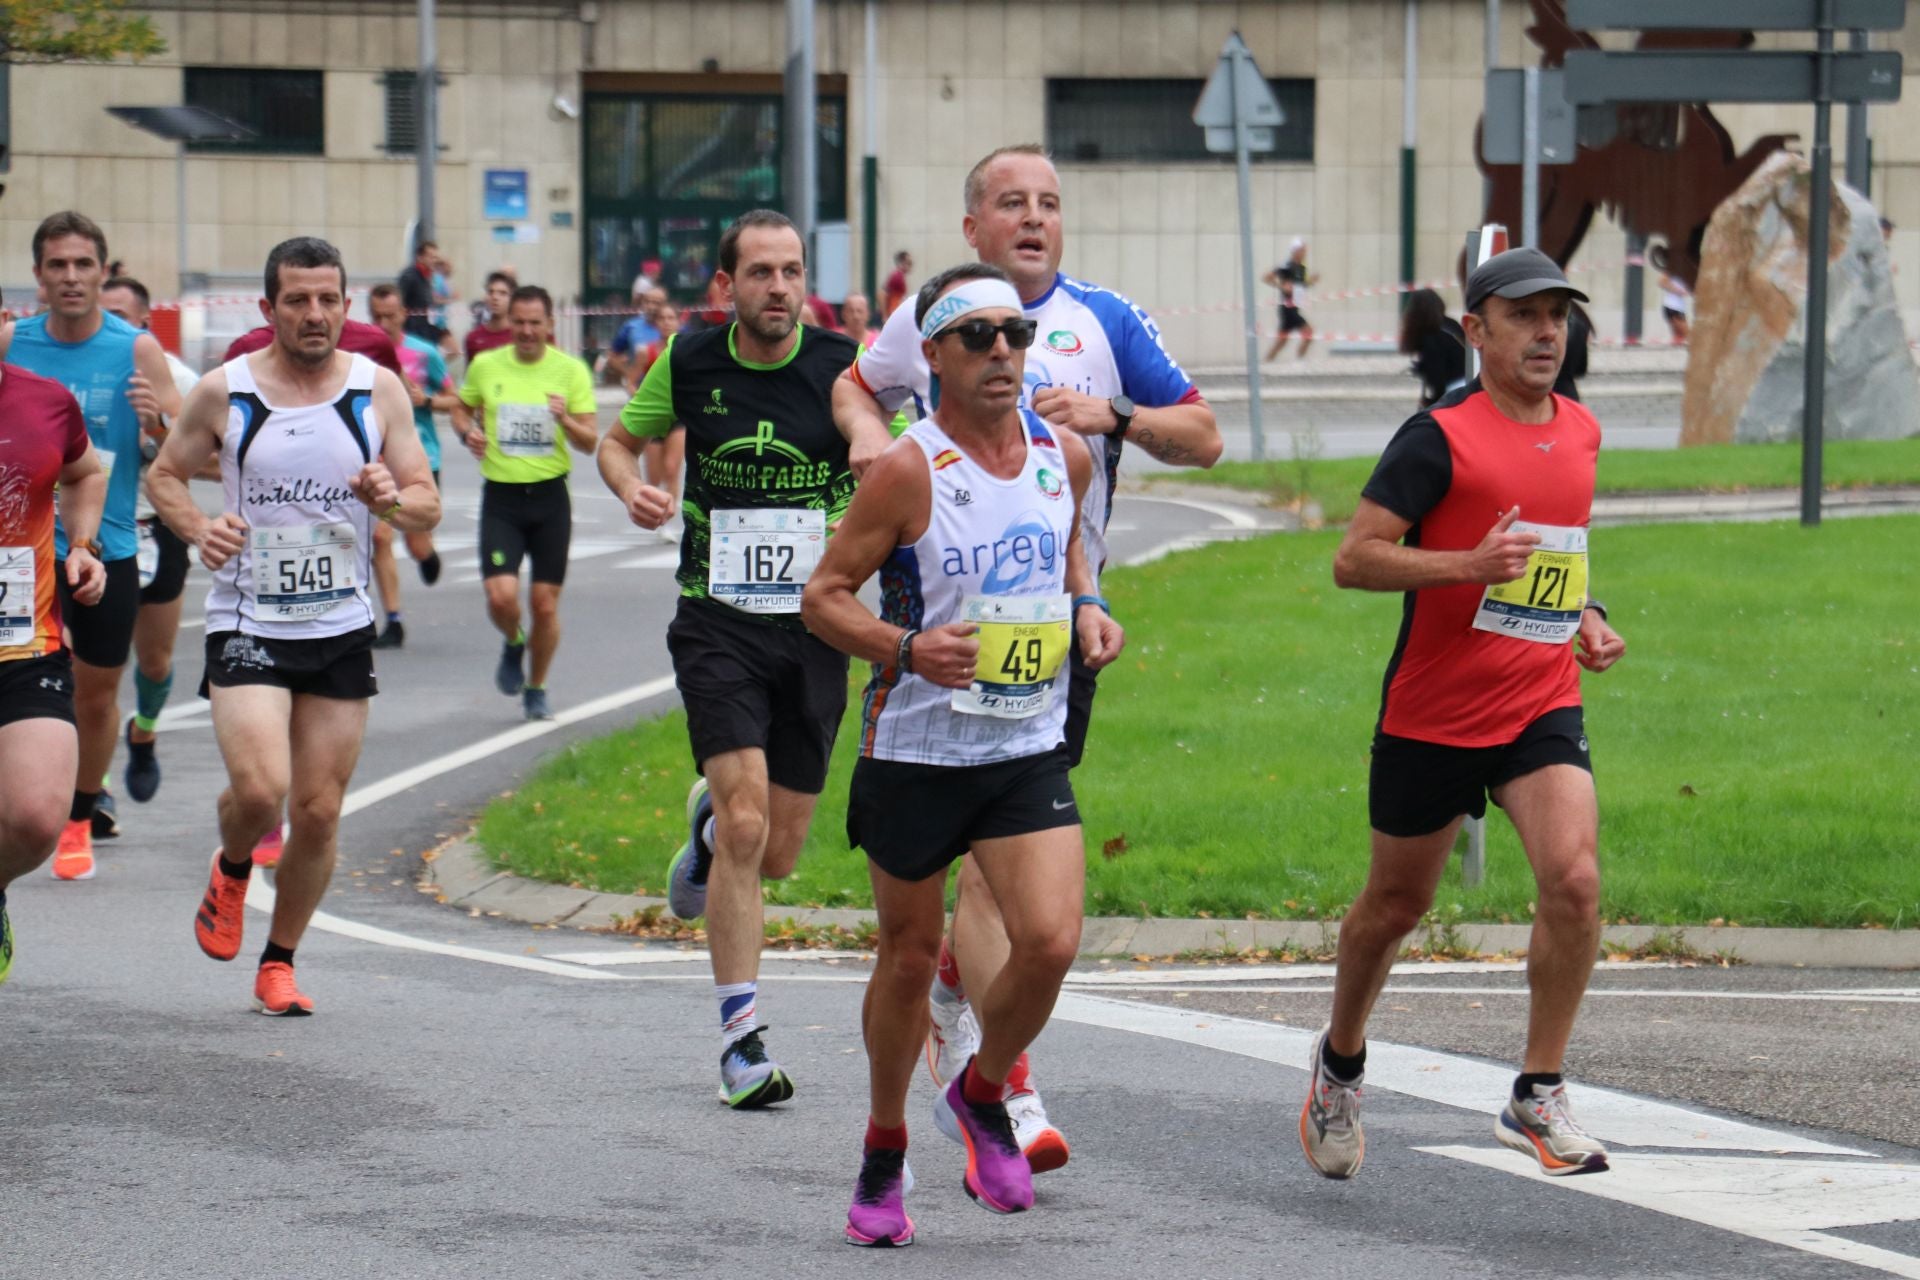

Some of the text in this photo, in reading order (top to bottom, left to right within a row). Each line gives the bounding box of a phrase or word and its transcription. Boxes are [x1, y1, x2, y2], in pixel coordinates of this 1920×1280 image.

[703, 405, 729, 416] AIMAR
[757, 460, 831, 490] PABLO
[278, 555, 333, 593] 549
[743, 545, 795, 583] 162
[1538, 552, 1573, 566] FERNANDO
[1526, 565, 1569, 609] 121
[1000, 638, 1042, 682] 49
